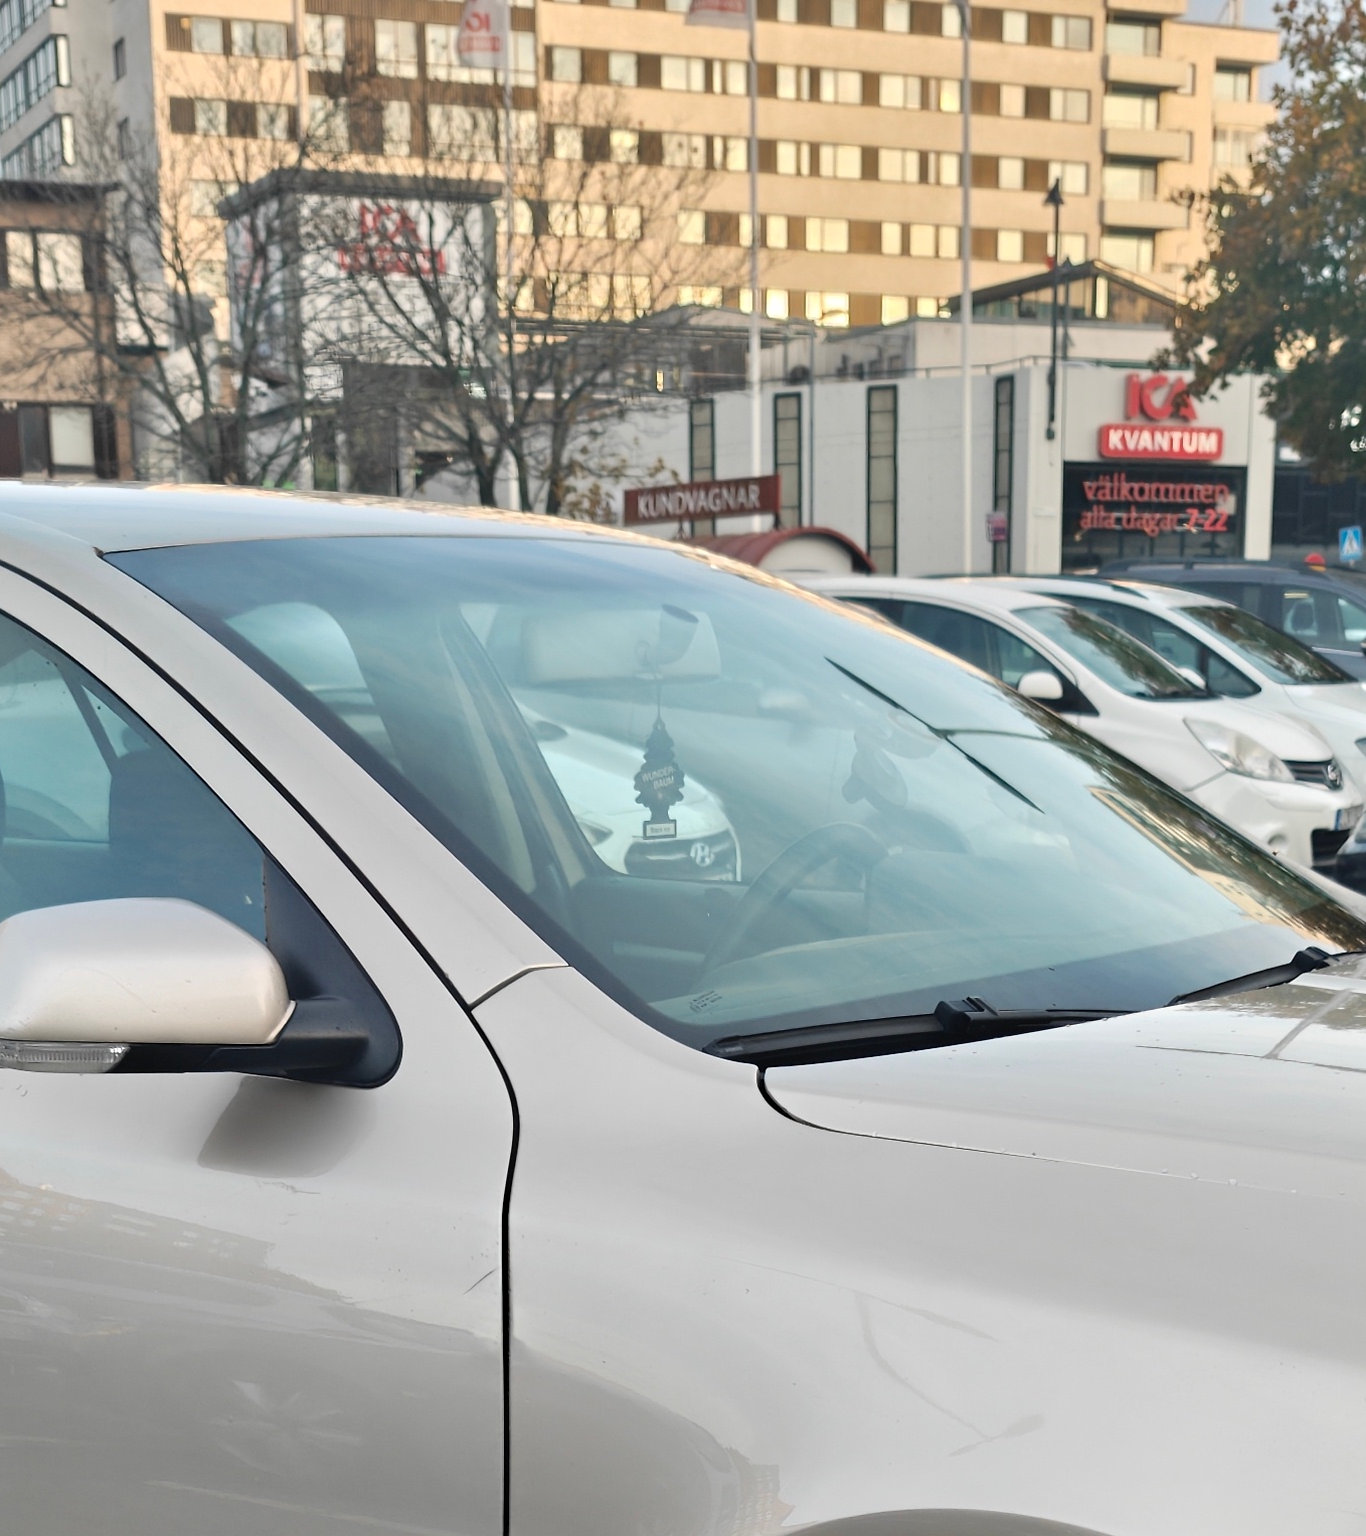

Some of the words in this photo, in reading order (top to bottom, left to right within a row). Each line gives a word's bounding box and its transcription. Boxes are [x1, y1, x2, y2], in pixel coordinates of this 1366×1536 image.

[1126, 373, 1198, 421] ICA
[1108, 428, 1219, 454] KVANTUM
[637, 483, 760, 519] KUNDVAGNAR
[1082, 472, 1230, 504] välkommen
[1080, 504, 1116, 529] alla
[1121, 505, 1180, 537] dagar
[1185, 507, 1228, 531] 7-22
